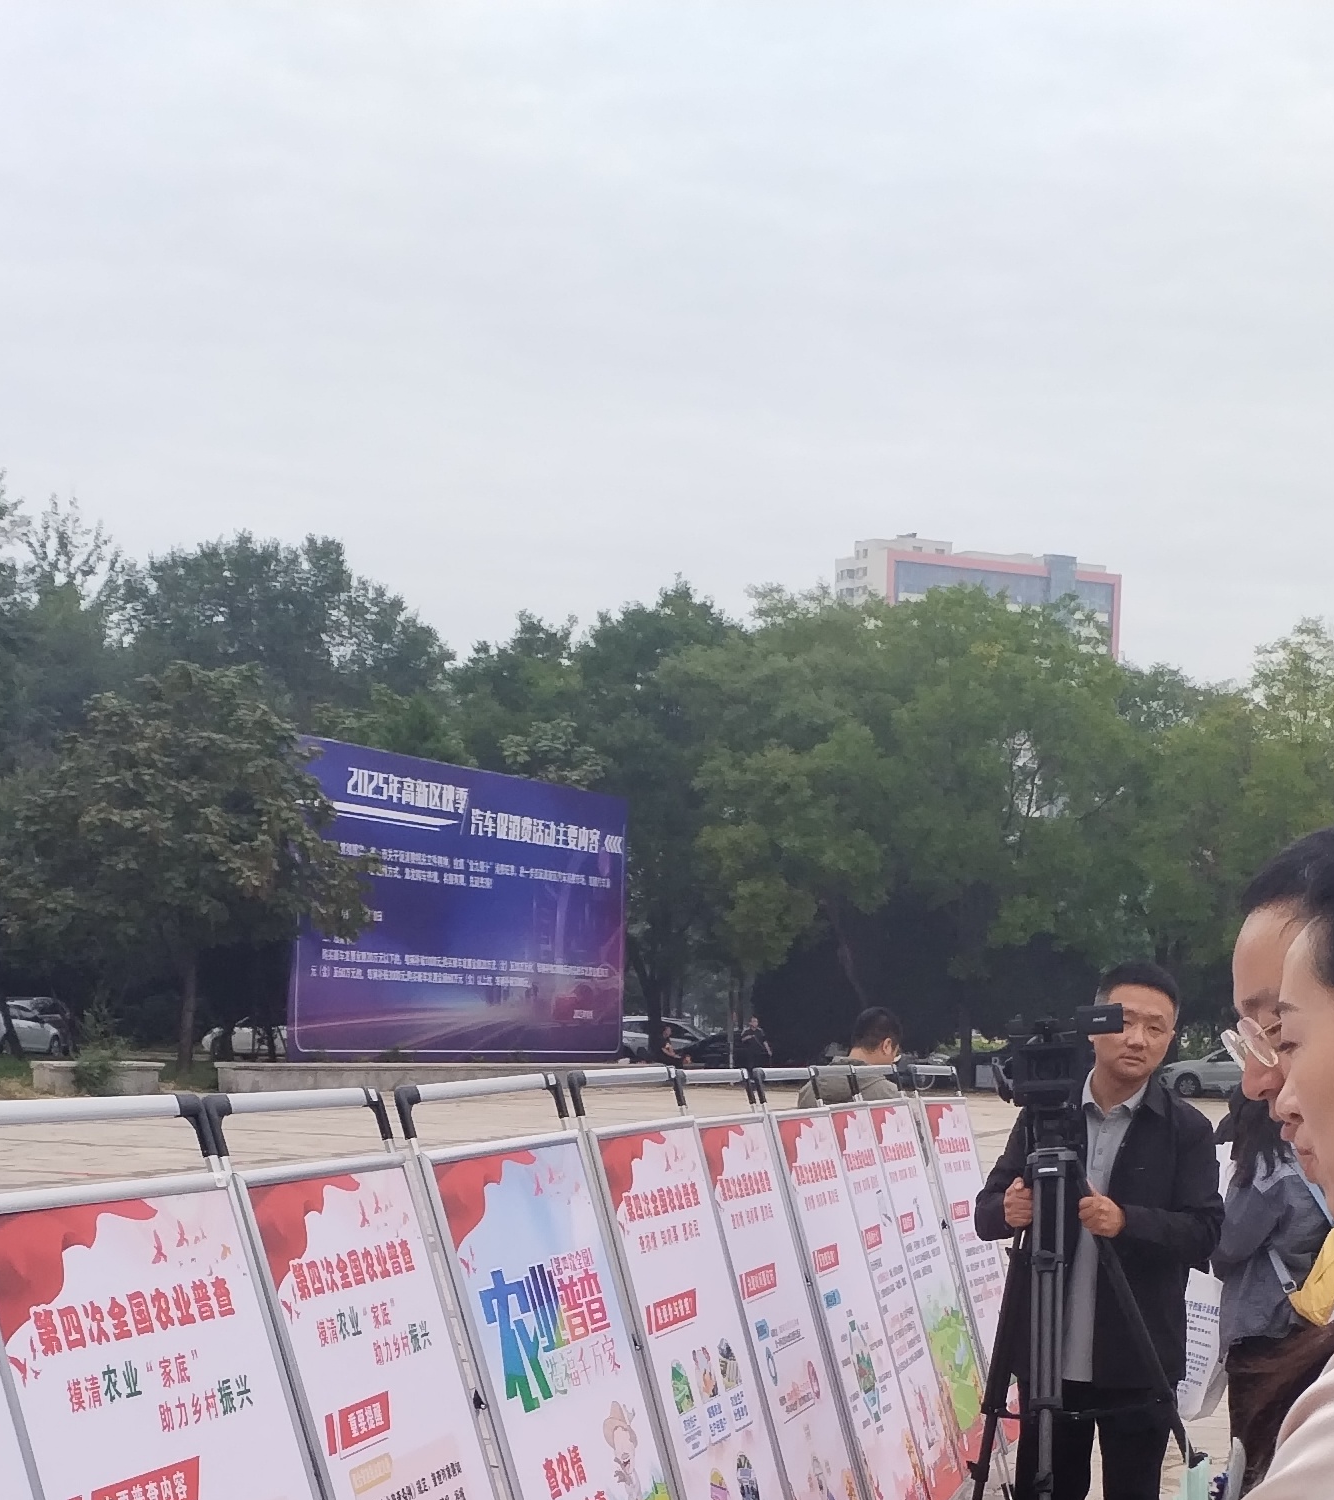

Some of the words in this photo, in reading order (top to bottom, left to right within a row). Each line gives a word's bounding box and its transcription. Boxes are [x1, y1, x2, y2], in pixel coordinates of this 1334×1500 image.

[347, 766, 469, 814] 2025年高新区秋季
[470, 808, 601, 854] 汽车促消费活动主要内容
[291, 1238, 416, 1302] 第四次全国农业普查
[33, 1276, 235, 1356] 第四次全国农业普查
[159, 1374, 254, 1432] 助力乡村振兴
[542, 1445, 588, 1500] 查农情
